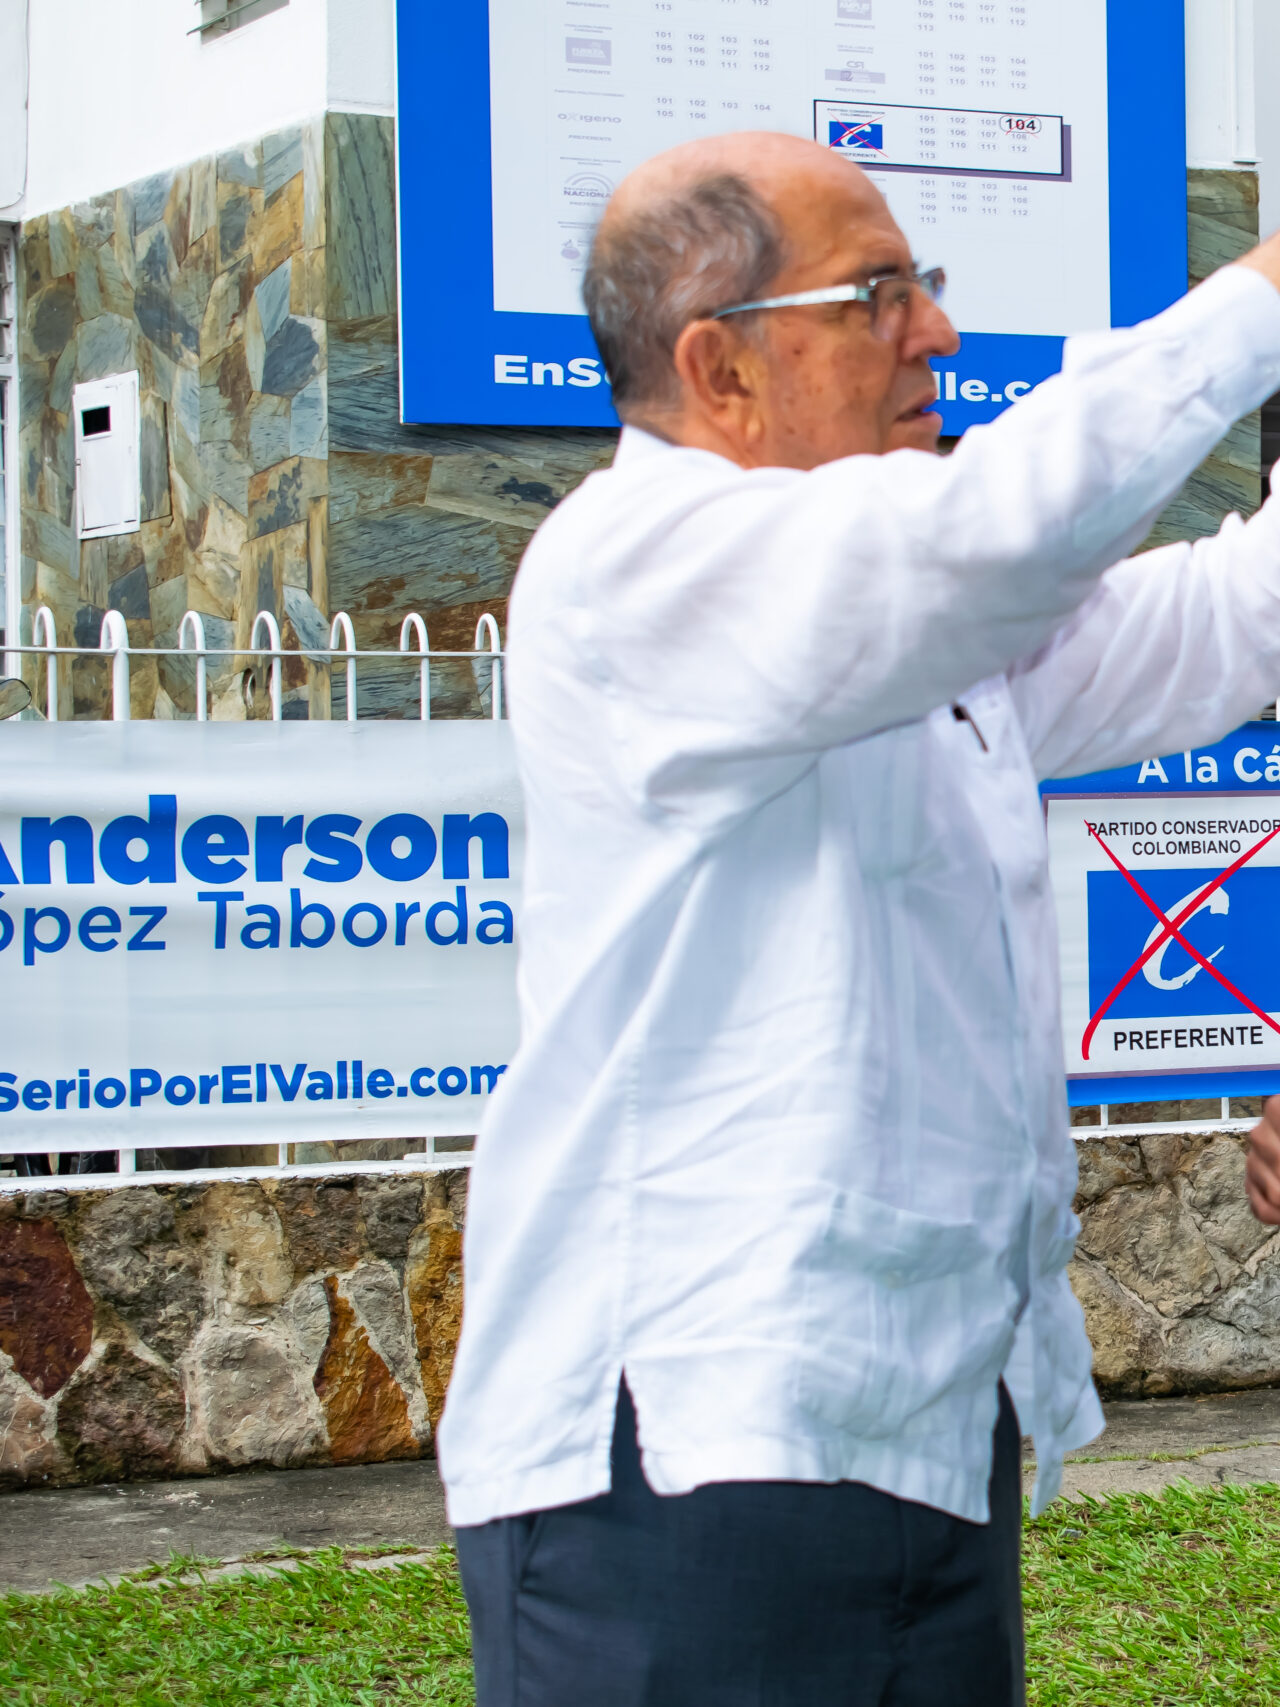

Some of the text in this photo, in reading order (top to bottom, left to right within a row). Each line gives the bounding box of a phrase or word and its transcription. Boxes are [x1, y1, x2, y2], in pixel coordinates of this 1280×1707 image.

[1004, 118, 1037, 131] 104
[494, 354, 612, 388] EnS
[1184, 750, 1218, 784] la
[1087, 820, 1158, 837] PARTIDO
[1132, 839, 1241, 856] COLOMBIANO
[197, 886, 513, 950] Taborda
[1113, 1025, 1264, 1052] PREFERENTE
